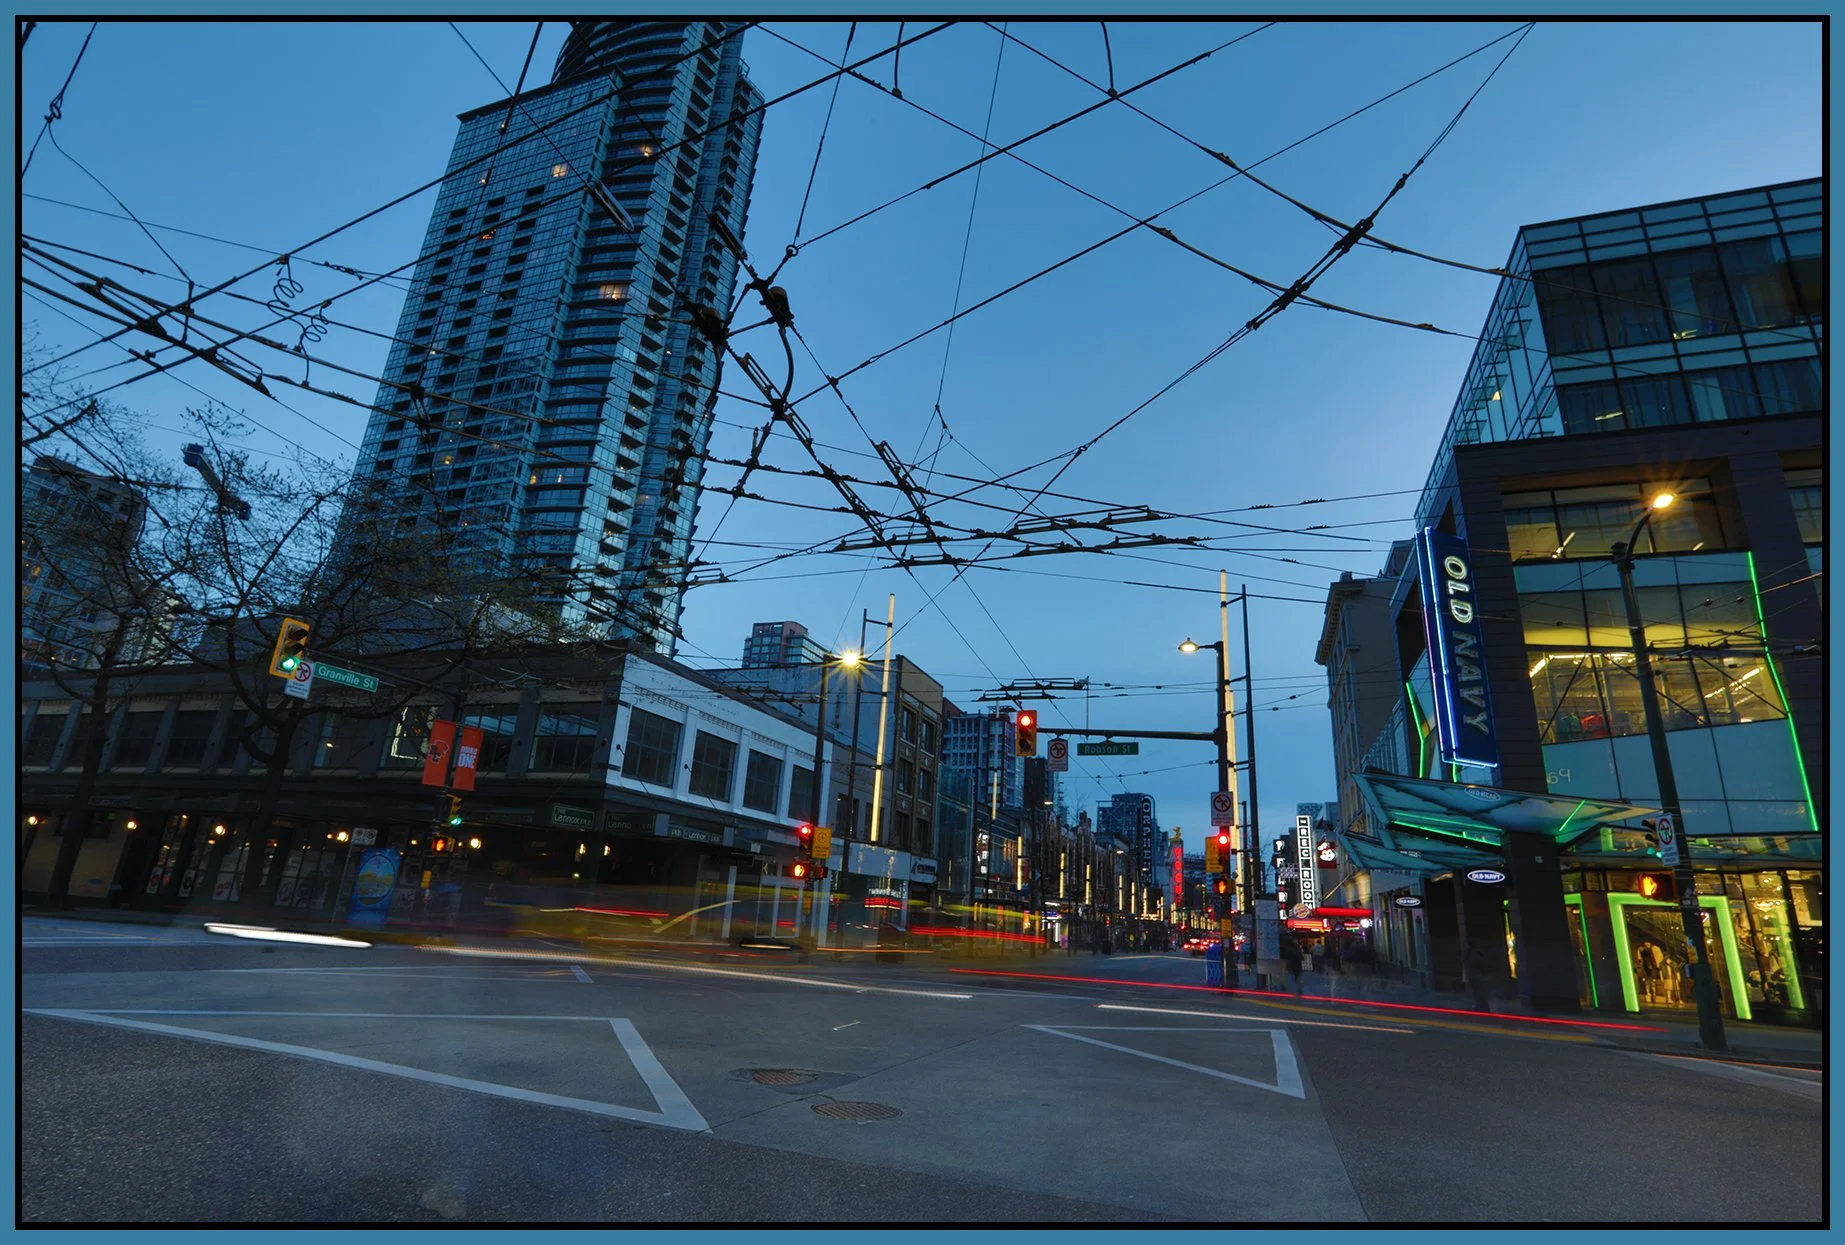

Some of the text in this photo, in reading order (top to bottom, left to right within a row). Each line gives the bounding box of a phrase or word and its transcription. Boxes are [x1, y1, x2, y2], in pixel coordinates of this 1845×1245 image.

[1444, 555, 1490, 735] OLD NAVY
[318, 665, 374, 689] Granville St
[457, 753, 476, 769] ONE
[1084, 744, 1131, 754] Robson St
[1300, 828, 1309, 859] REC
[1302, 869, 1314, 910] ROOM
